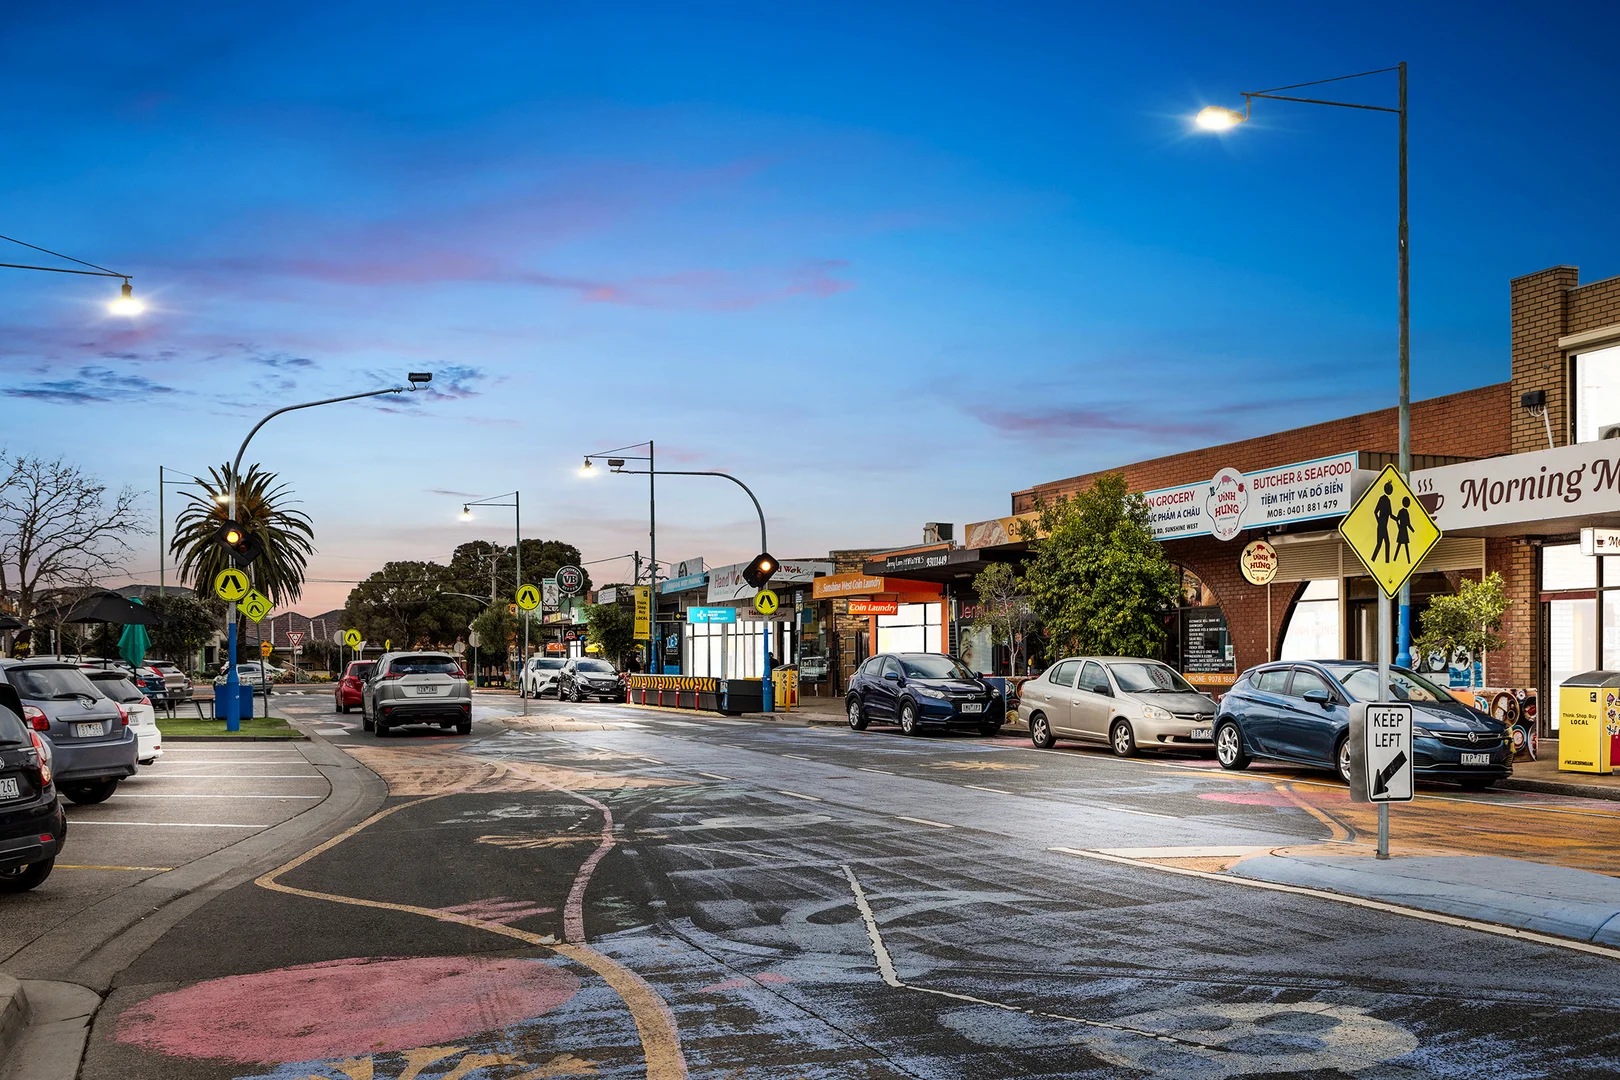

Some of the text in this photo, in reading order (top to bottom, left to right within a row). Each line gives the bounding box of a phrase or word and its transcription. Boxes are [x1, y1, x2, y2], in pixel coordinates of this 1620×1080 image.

[1254, 462, 1352, 490] BUTCHER & SEAFOOD
[1460, 464, 1586, 511] Morning
[1156, 490, 1195, 507] GROCERY
[1267, 499, 1337, 518] MOB: 0401 881 479
[1165, 524, 1186, 533] SUNSHINE
[1186, 523, 1198, 531] WEST
[823, 577, 881, 592] Sunshine West Coin Laundry
[868, 604, 897, 613] Laundry
[1374, 713, 1403, 727] KEEP
[1375, 733, 1401, 747] LEFT
